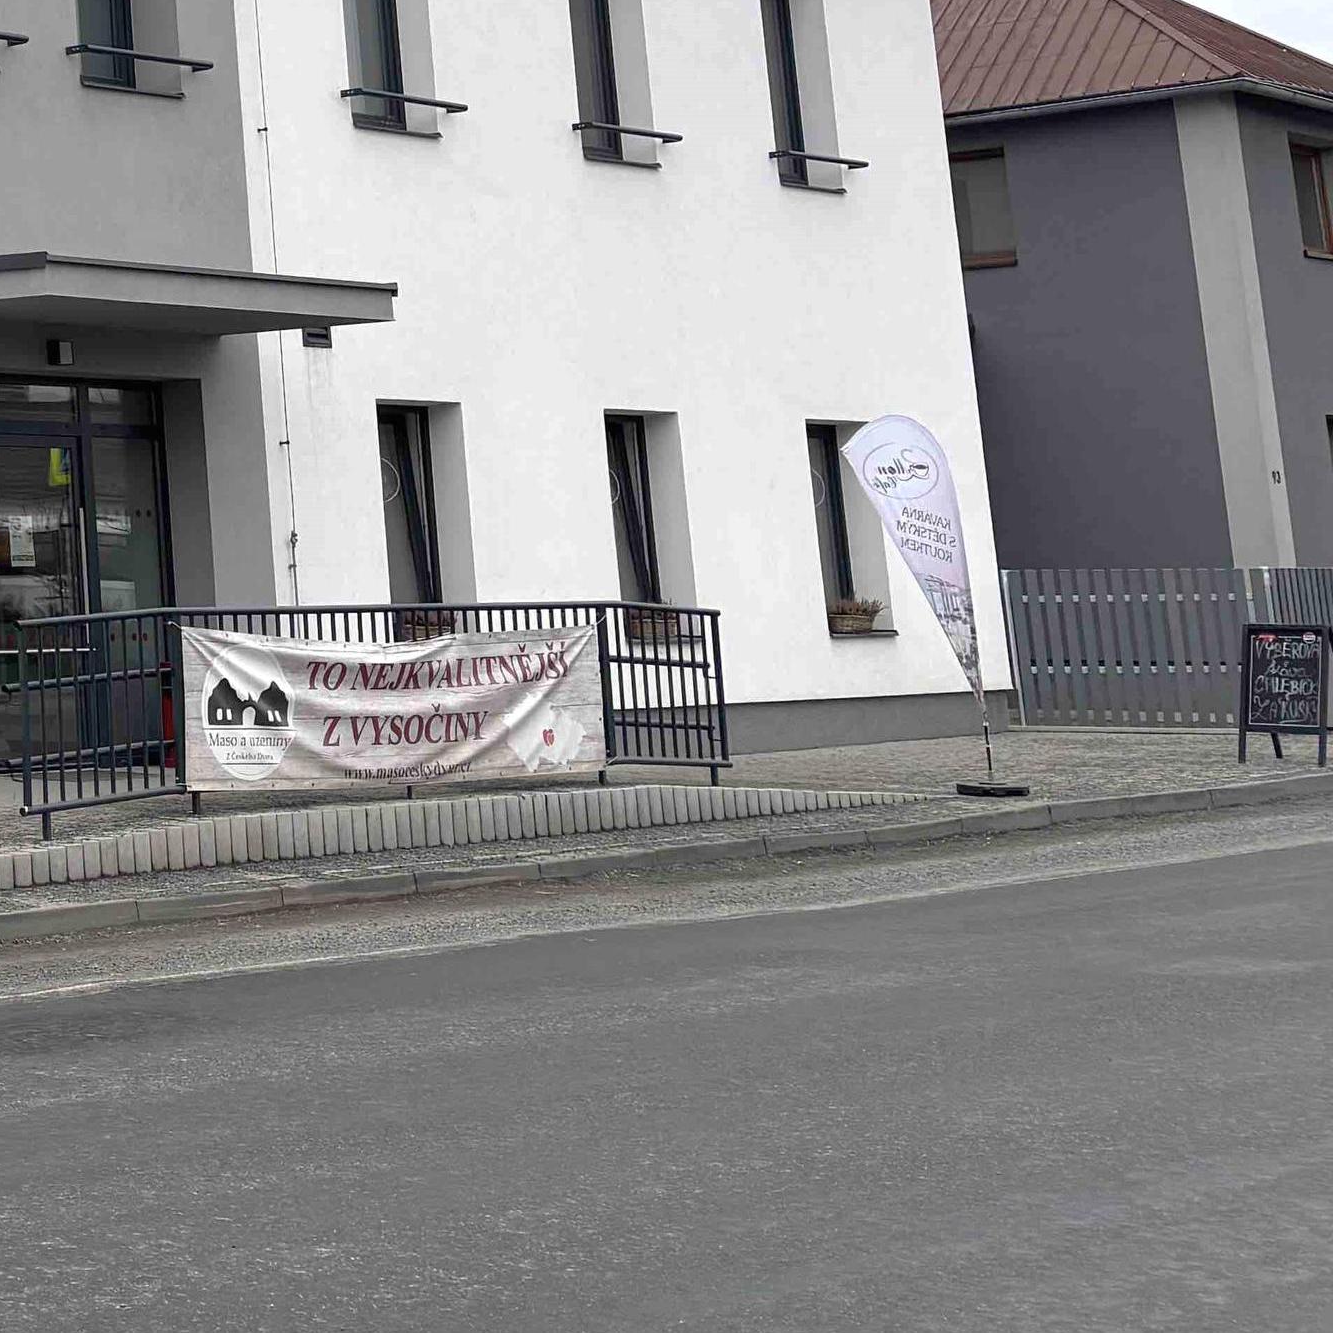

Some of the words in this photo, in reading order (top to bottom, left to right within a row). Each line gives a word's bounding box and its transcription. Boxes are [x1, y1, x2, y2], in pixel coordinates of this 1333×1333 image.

[307, 661, 347, 690] TO
[350, 641, 569, 691] NEJKVALITNĚJŠÍ
[208, 732, 238, 747] Maso
[240, 736, 247, 747] a
[249, 736, 292, 751] uzeniny
[322, 715, 343, 747] Z
[349, 703, 489, 746] VYSOČINY
